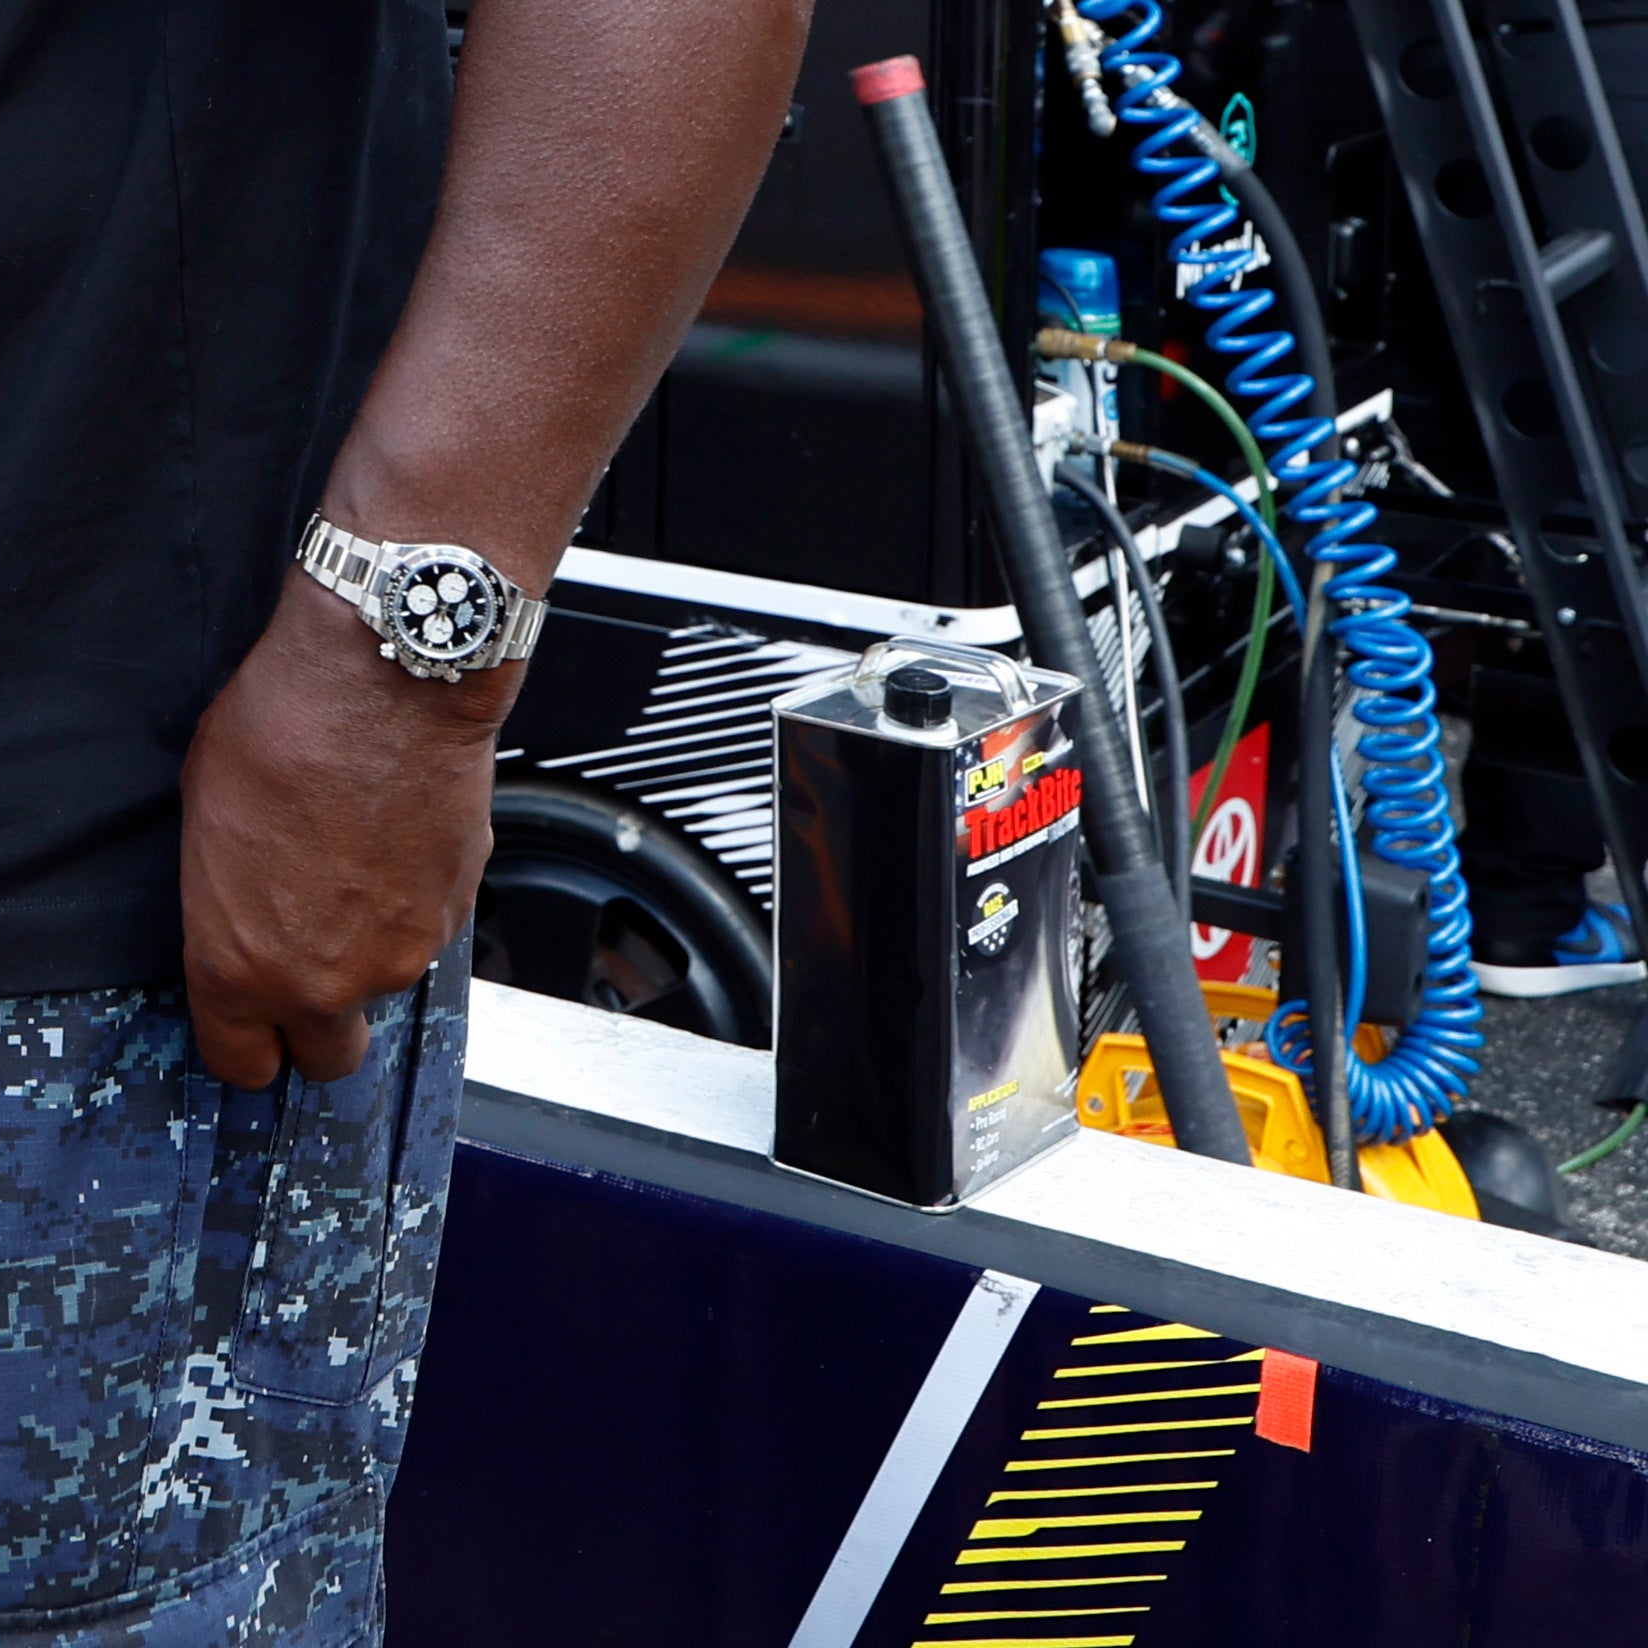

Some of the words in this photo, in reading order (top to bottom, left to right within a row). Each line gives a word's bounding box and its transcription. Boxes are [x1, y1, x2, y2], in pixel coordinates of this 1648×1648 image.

[969, 759, 1005, 796] PJH
[965, 767, 1083, 860] TrackBite
[968, 1078, 1020, 1112] APPLICATIONS
